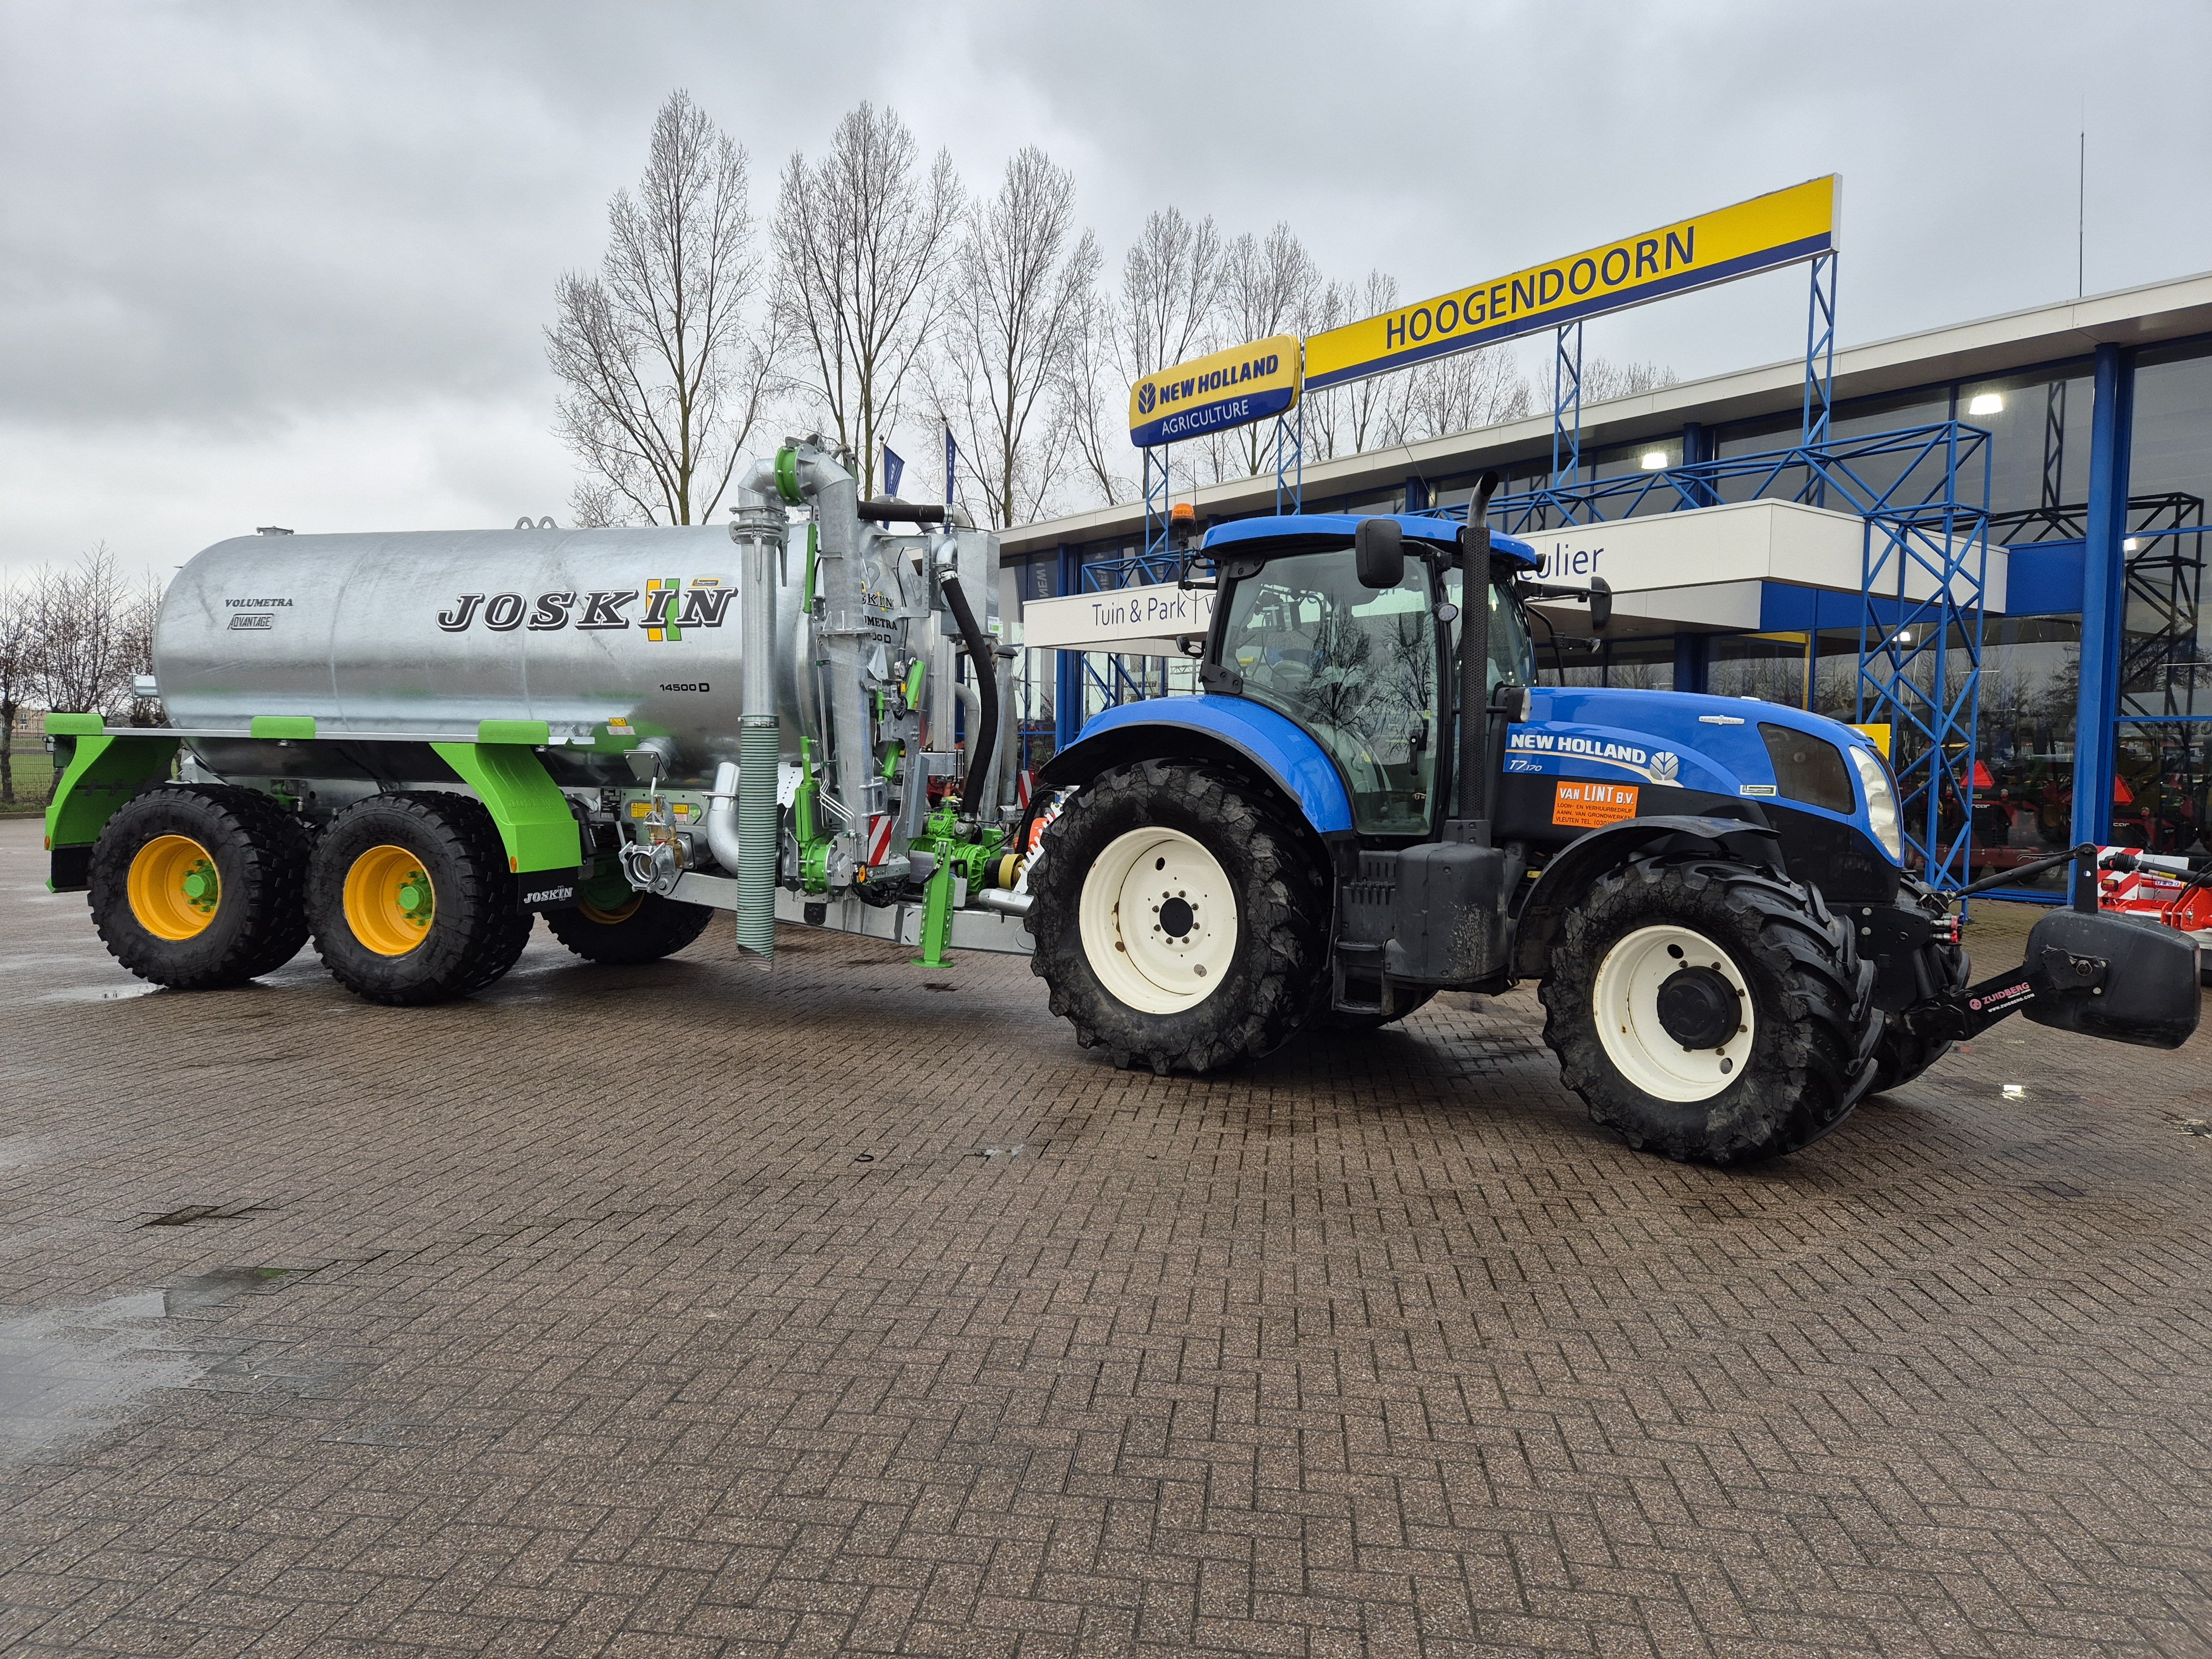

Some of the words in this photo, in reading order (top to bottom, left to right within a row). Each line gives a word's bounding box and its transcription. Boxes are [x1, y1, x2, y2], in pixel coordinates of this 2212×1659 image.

[1386, 225, 1694, 349] HOOGENDOORN
[1160, 377, 1195, 404] NEW
[1198, 354, 1279, 394] HOLLAND
[1161, 399, 1249, 436] AGRICULTURE
[225, 598, 293, 607] VOLUMETRA
[436, 586, 739, 632] JOSKIN
[1092, 602, 1124, 626] Tuin
[1130, 599, 1141, 623] &
[1147, 592, 1186, 621] Park
[227, 616, 272, 630] ADVANTAGE
[698, 682, 710, 692] D
[1511, 734, 1555, 749] NEW
[1558, 736, 1646, 764] HOLLAND
[1509, 759, 1543, 772] T7.170
[1559, 787, 1580, 800] VAN
[1584, 785, 1614, 803] LINT
[1616, 791, 1634, 805] B.V.
[1585, 805, 1633, 813] VERHUURBEDRIJF
[523, 886, 573, 904] JOSKIN
[1981, 982, 2030, 1005] ZUIDBERG
